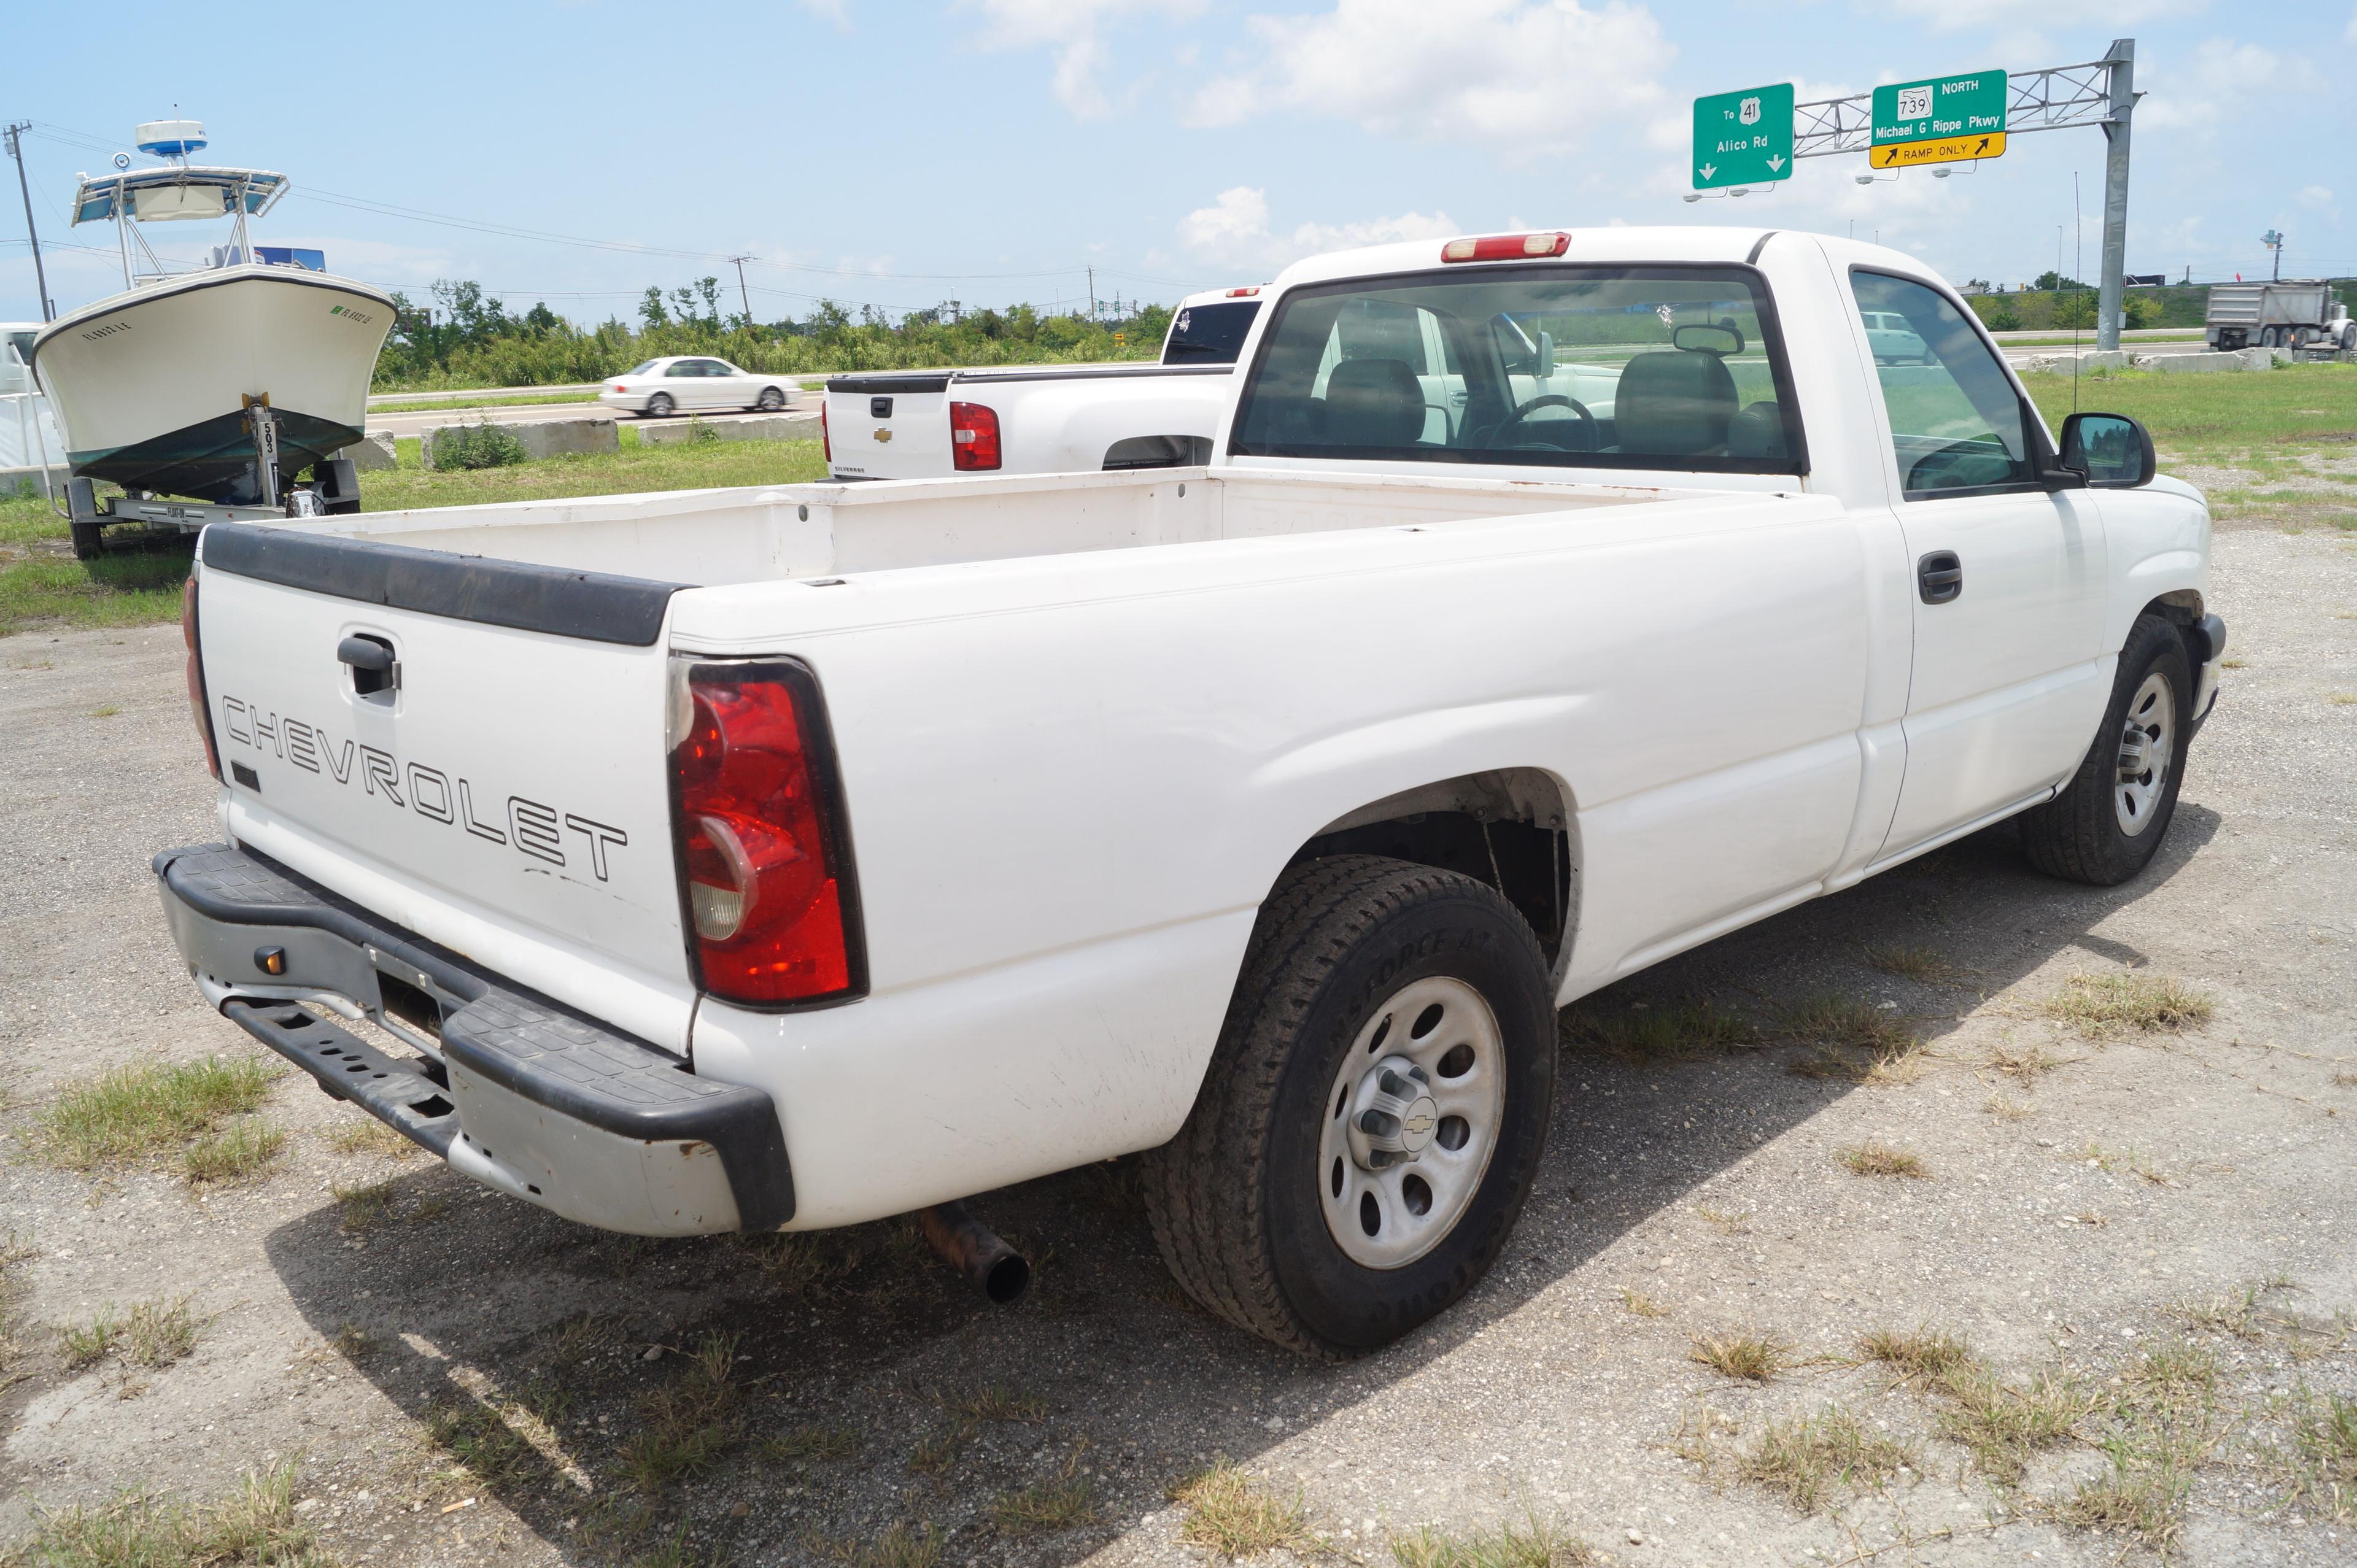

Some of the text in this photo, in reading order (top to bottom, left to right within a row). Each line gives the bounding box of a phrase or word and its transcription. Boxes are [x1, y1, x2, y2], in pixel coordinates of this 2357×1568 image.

[1900, 80, 1979, 114] 739 NORTH
[1724, 102, 1755, 120] To 41
[1876, 115, 2000, 139] Michael G Rippe Pkwy
[1716, 135, 1768, 153] Alico Rd
[1903, 144, 1968, 160] RAMP ONLY
[265, 422, 273, 453] 503
[222, 695, 628, 882] CHEVROLET
